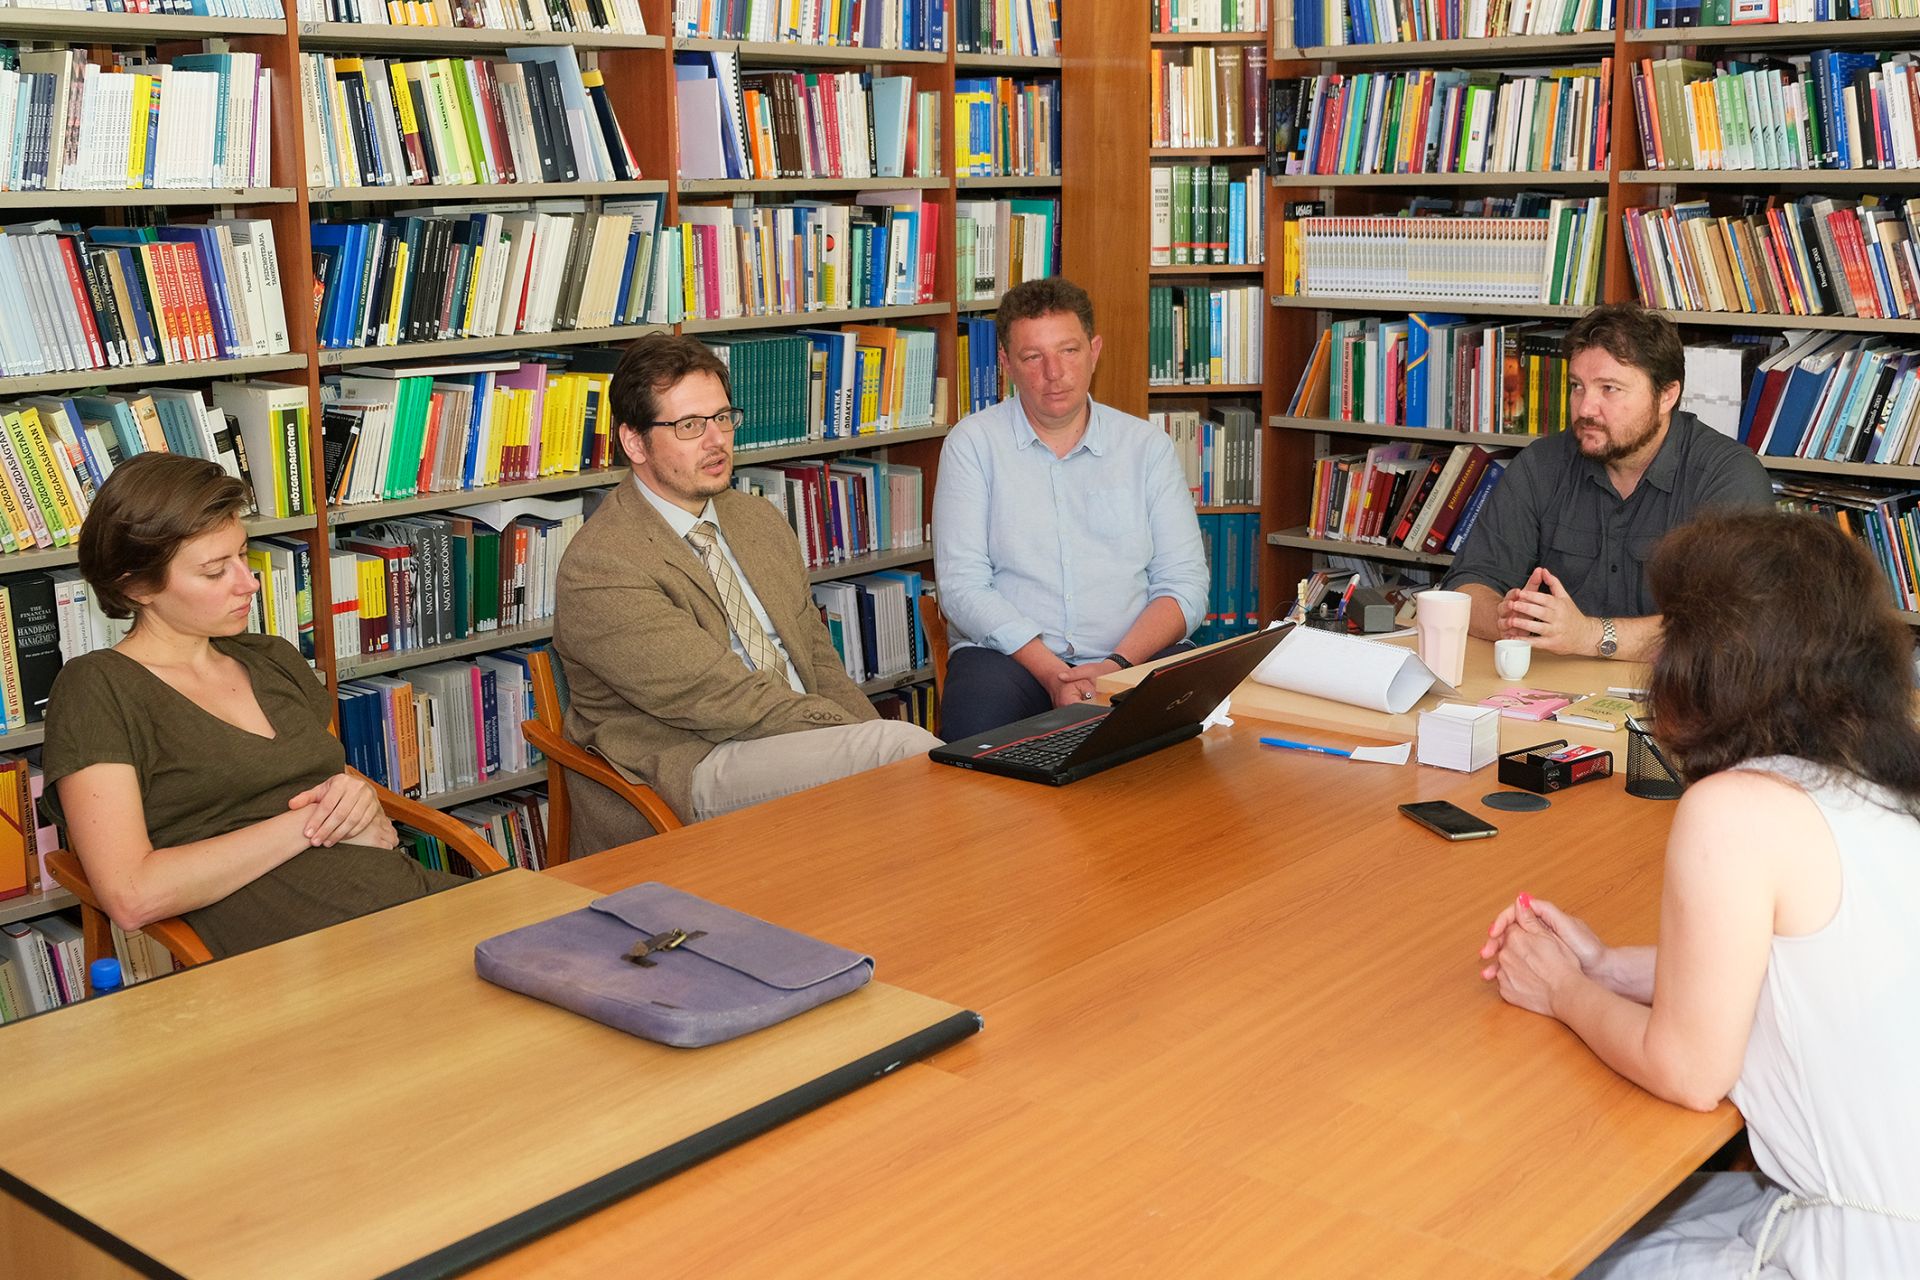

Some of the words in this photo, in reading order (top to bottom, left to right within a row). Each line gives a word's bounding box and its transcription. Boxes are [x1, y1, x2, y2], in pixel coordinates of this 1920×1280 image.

[1180, 225, 1184, 234] 1
[1197, 225, 1203, 234] 2
[1216, 226, 1222, 234] 3
[242, 251, 252, 293] Pszichoterápia
[258, 232, 270, 280] PSZICHOTERÁPIA
[268, 251, 277, 286] TANKÖNYVE
[1816, 262, 1828, 287] Droginfo
[11, 420, 21, 430] II.
[845, 388, 853, 428] DIDAKTIKA
[1863, 409, 1879, 434] Droginfo
[0, 430, 35, 511] KÖZGAZDASÁGTAN
[16, 431, 53, 509] KÖZGAZDASÁGTAN
[32, 428, 68, 507] KÖZGAZDASÁGTAN
[286, 423, 300, 505] KÖZGAZDASÁGTAN
[300, 552, 309, 568] 2000
[422, 538, 432, 590] DROGKÖNYV
[441, 534, 450, 586] DROGKÖNYV
[303, 568, 311, 616] Magyarország
